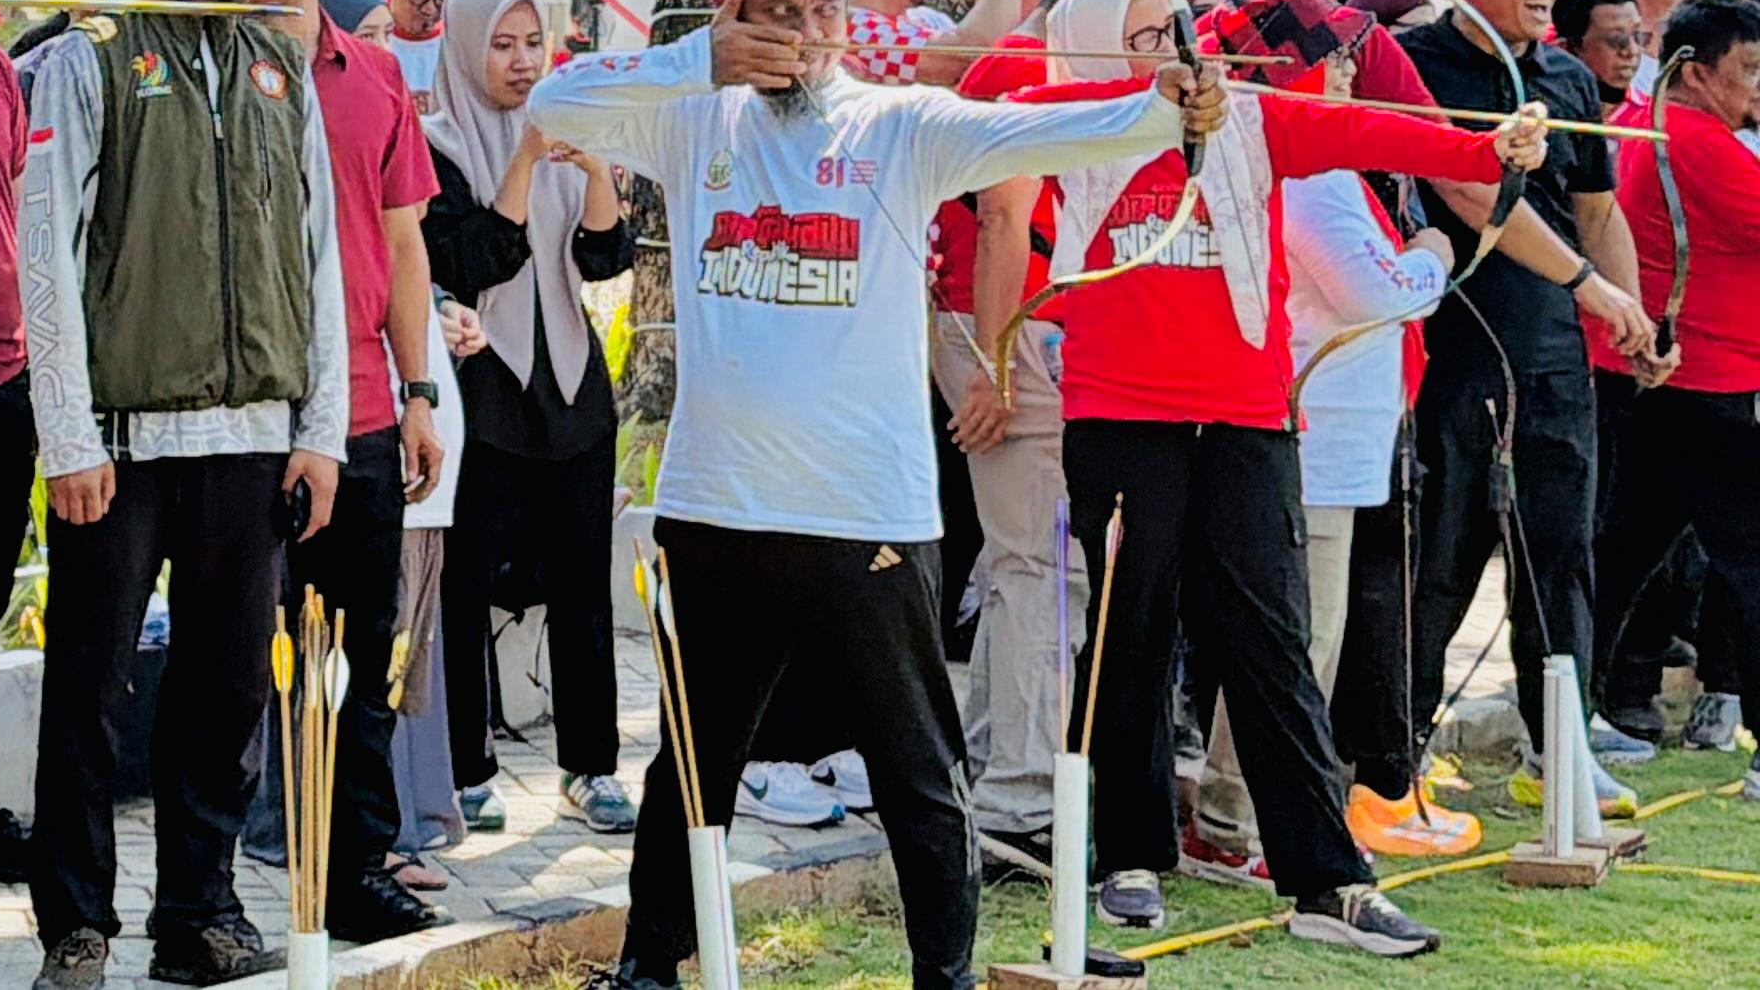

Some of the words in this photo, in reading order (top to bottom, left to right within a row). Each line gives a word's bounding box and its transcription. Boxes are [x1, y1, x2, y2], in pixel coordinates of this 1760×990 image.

[816, 156, 846, 188] 81
[1108, 221, 1224, 268] INDONE
[697, 244, 859, 307] INDONESIA
